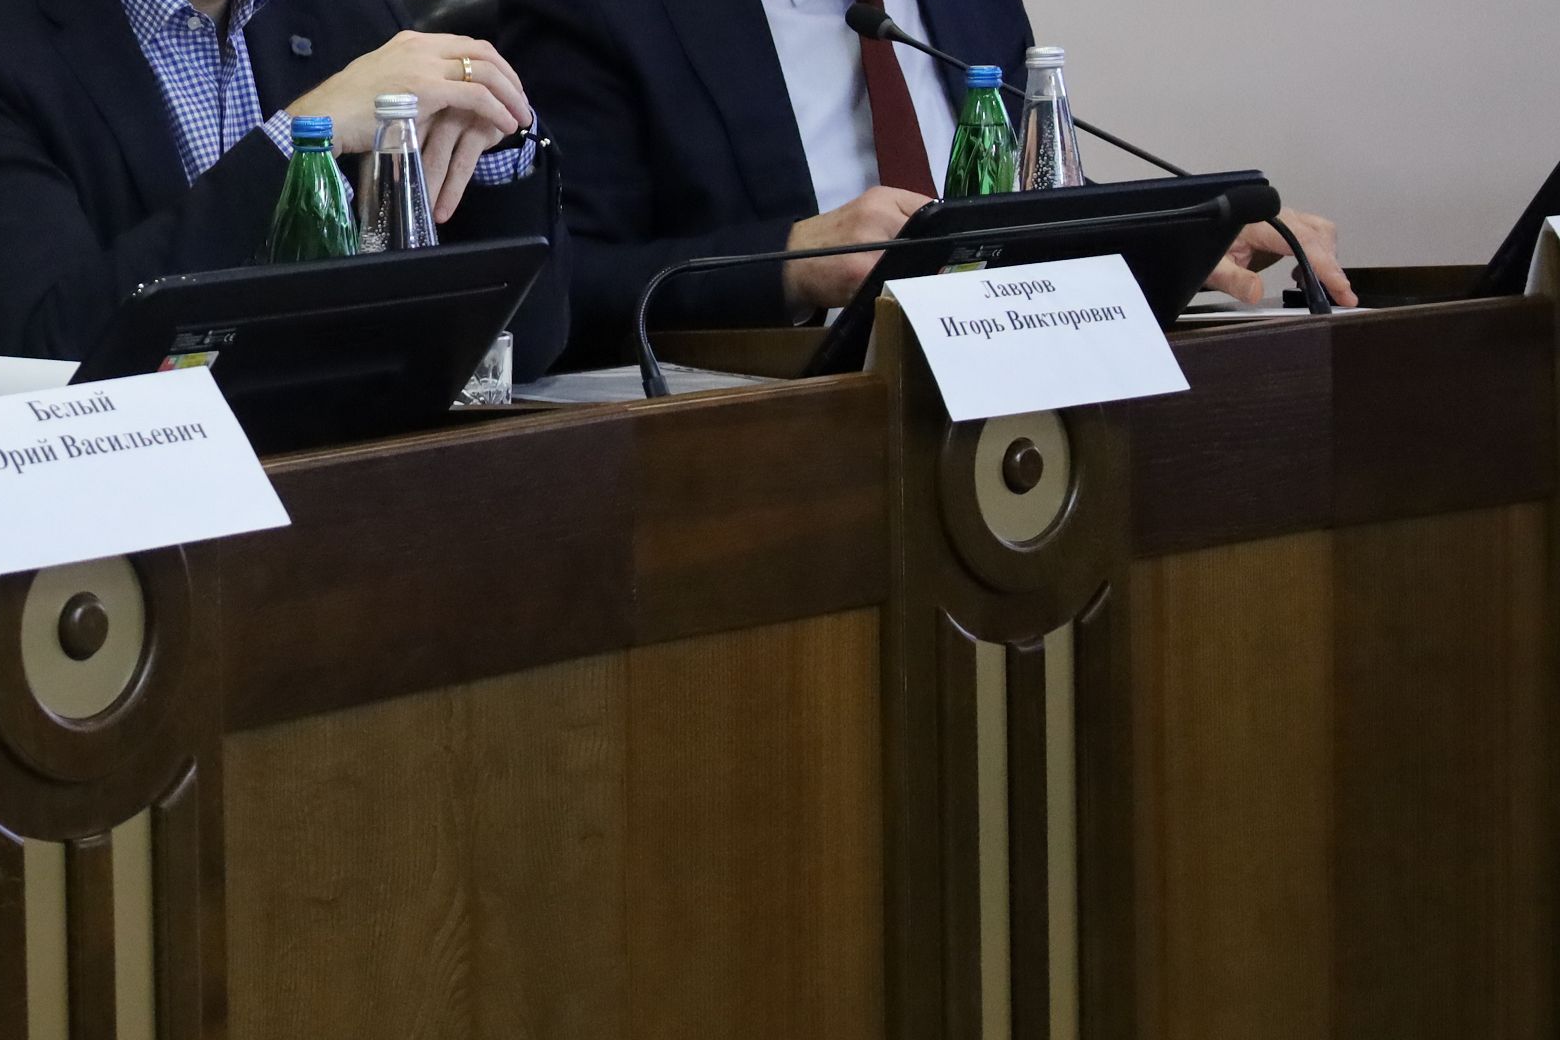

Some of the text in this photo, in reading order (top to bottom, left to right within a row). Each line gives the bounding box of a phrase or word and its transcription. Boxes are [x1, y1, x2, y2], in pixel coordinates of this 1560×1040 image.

[980, 278, 1056, 301] Лавров
[938, 305, 1127, 340] Игорь Викторович
[26, 391, 116, 422] Белый
[59, 421, 208, 459] Васильевич
